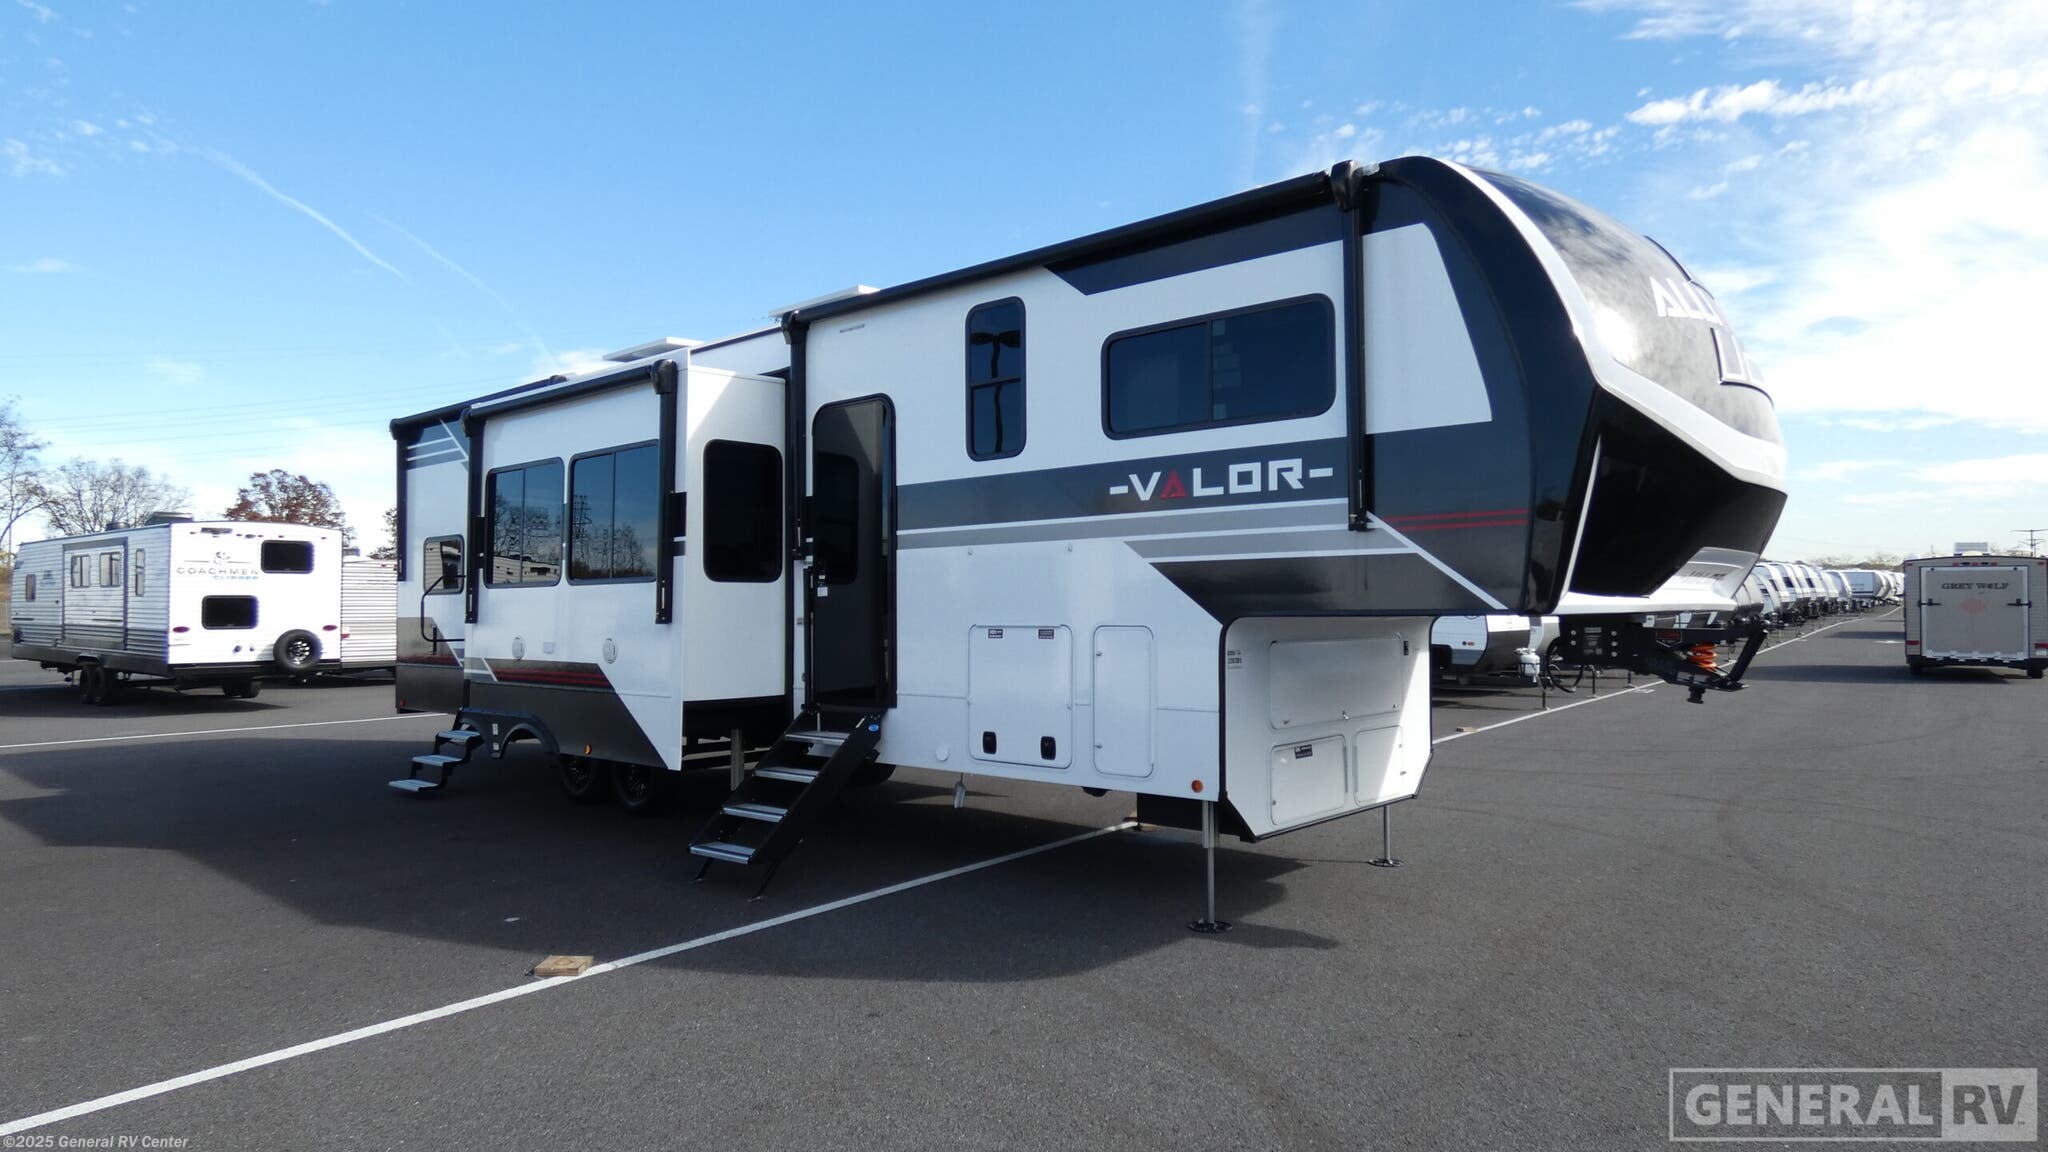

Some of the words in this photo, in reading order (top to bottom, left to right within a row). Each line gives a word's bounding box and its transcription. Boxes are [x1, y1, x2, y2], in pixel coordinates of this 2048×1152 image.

[176, 567, 259, 576] COACHMEN
[1942, 582, 1973, 590] GREY
[1975, 582, 2009, 590] WOLF
